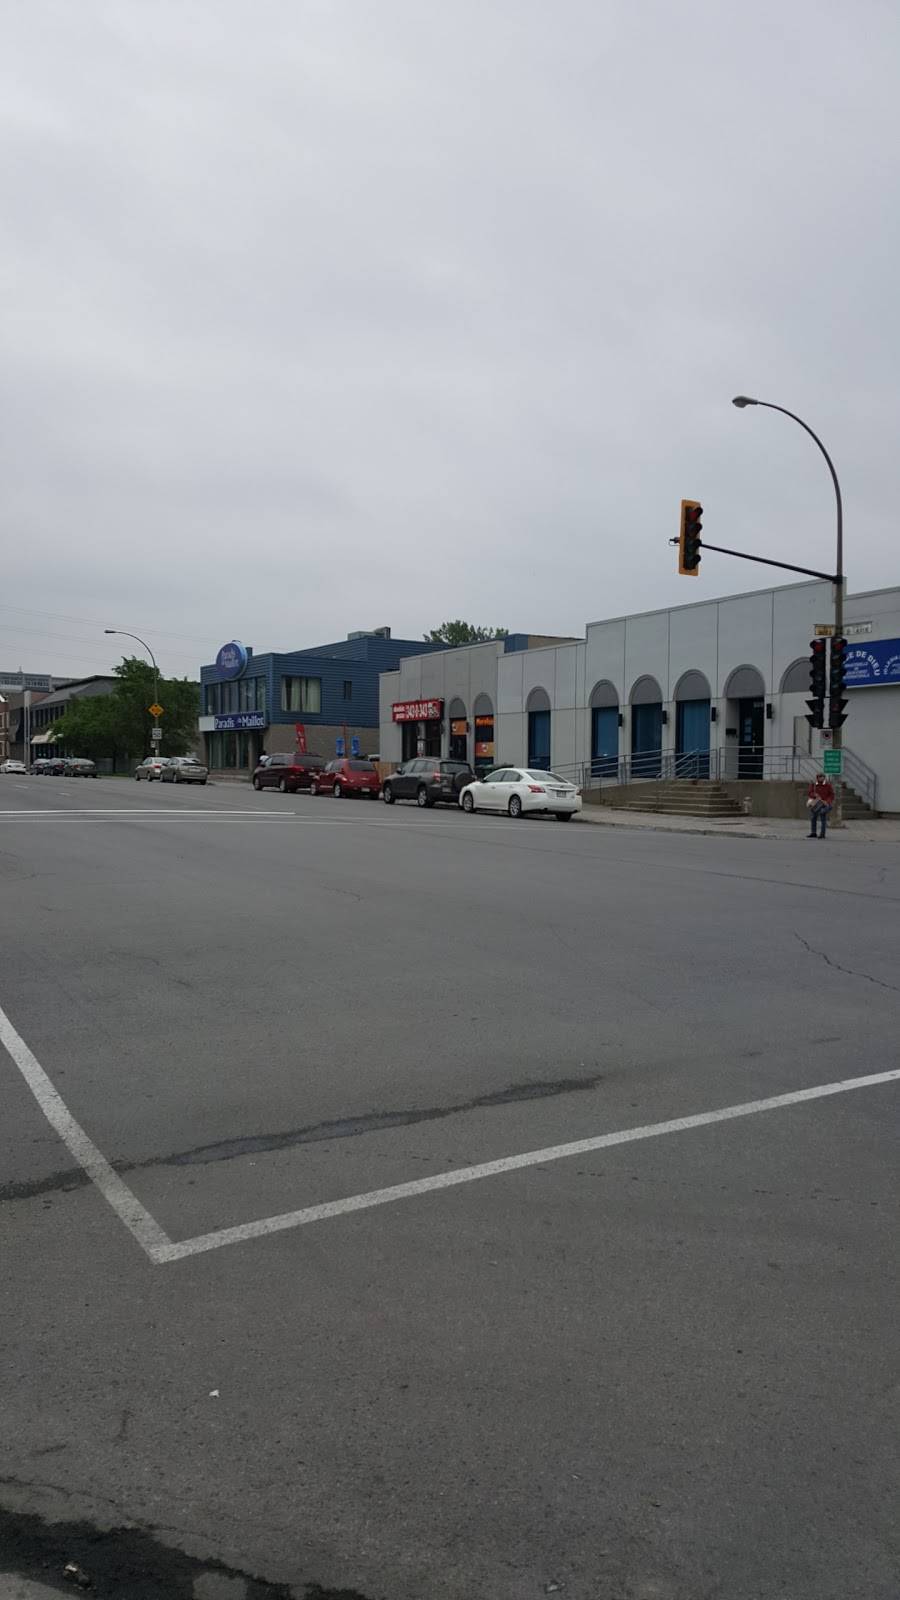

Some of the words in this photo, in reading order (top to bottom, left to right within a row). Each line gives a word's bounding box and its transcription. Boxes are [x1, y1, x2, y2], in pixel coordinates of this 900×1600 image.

[856, 650, 867, 658] DE
[867, 655, 881, 676] DIEU
[215, 717, 235, 729] Paradis
[241, 715, 264, 727] Maillot
